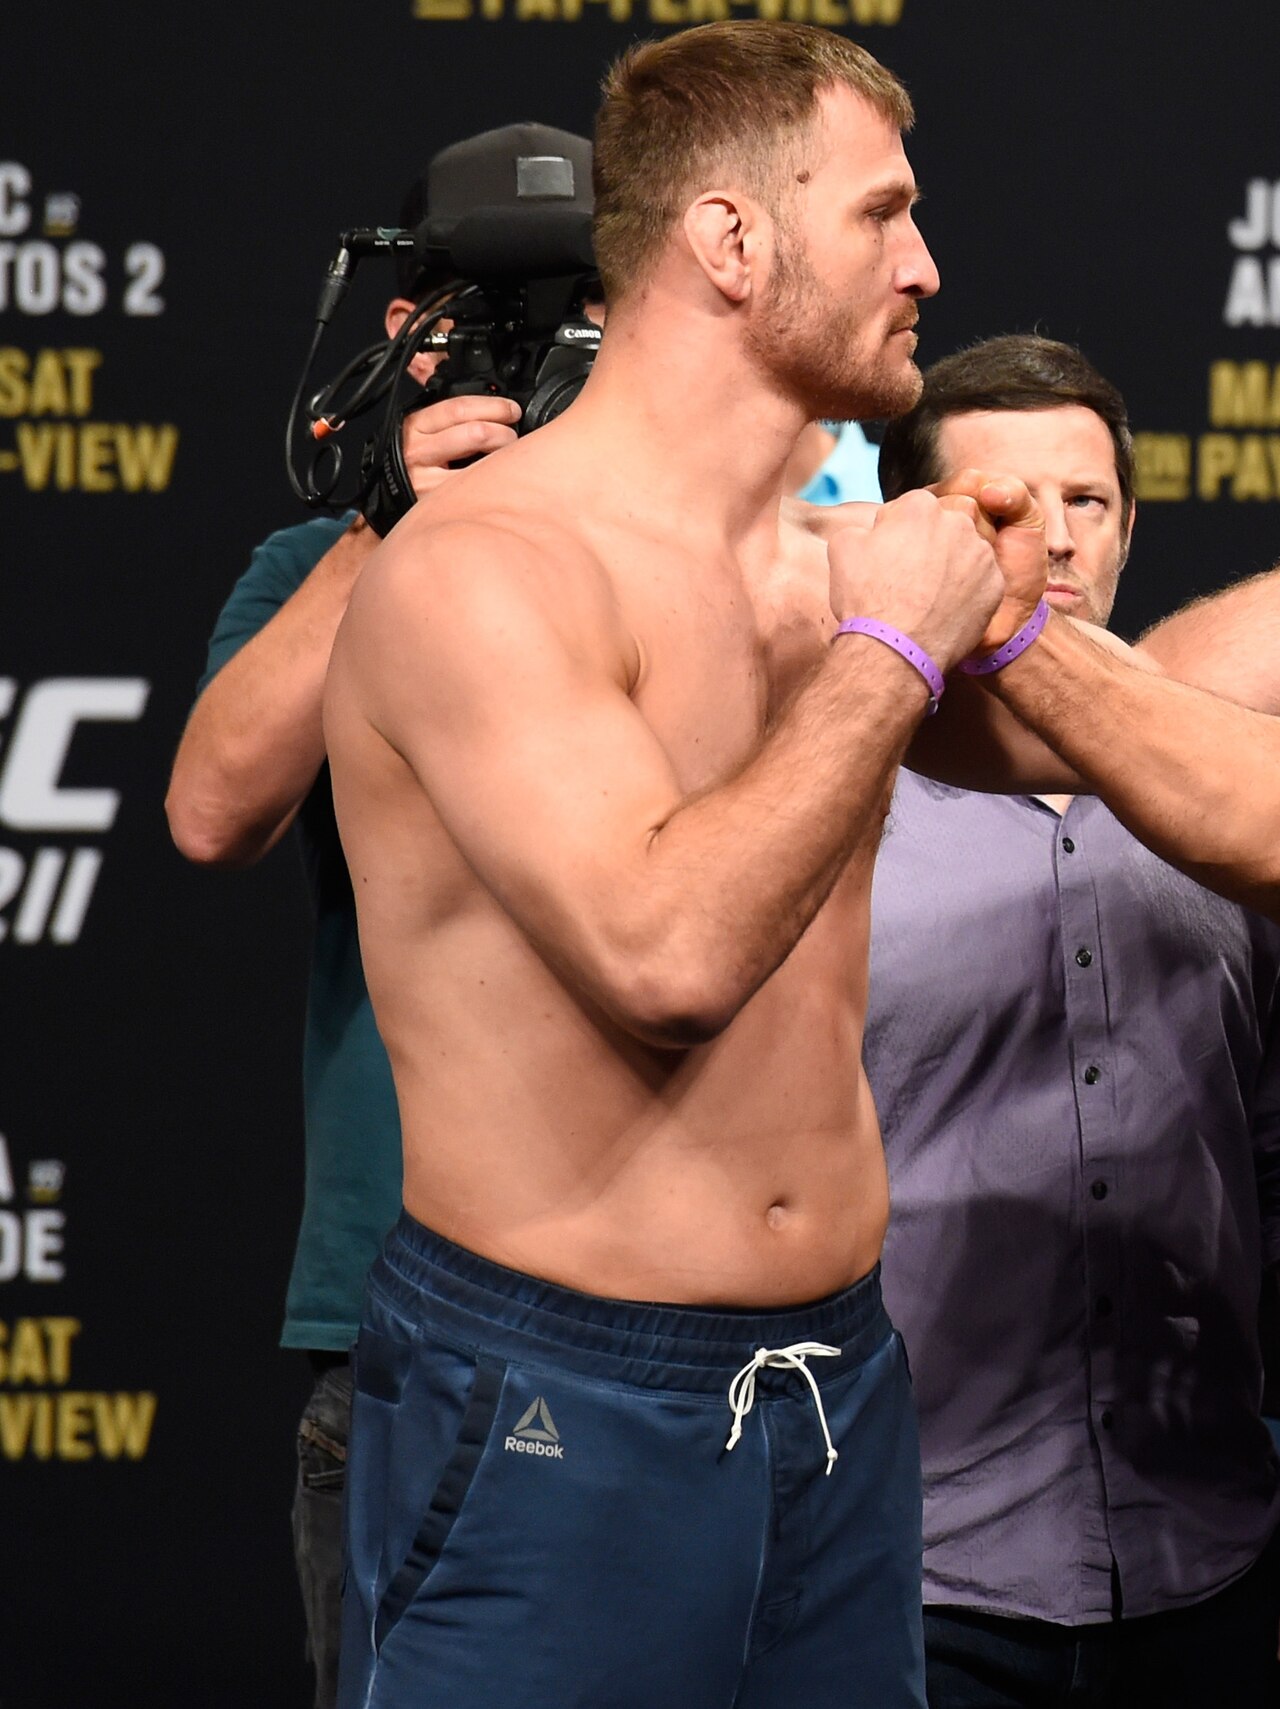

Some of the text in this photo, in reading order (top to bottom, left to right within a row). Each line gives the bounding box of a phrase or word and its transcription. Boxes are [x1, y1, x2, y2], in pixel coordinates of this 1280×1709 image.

[122, 242, 166, 317] 2
[564, 328, 601, 339] Canon
[0, 346, 102, 418] SAT
[0, 1315, 81, 1388] AT
[504, 1436, 564, 1459] Reebok
